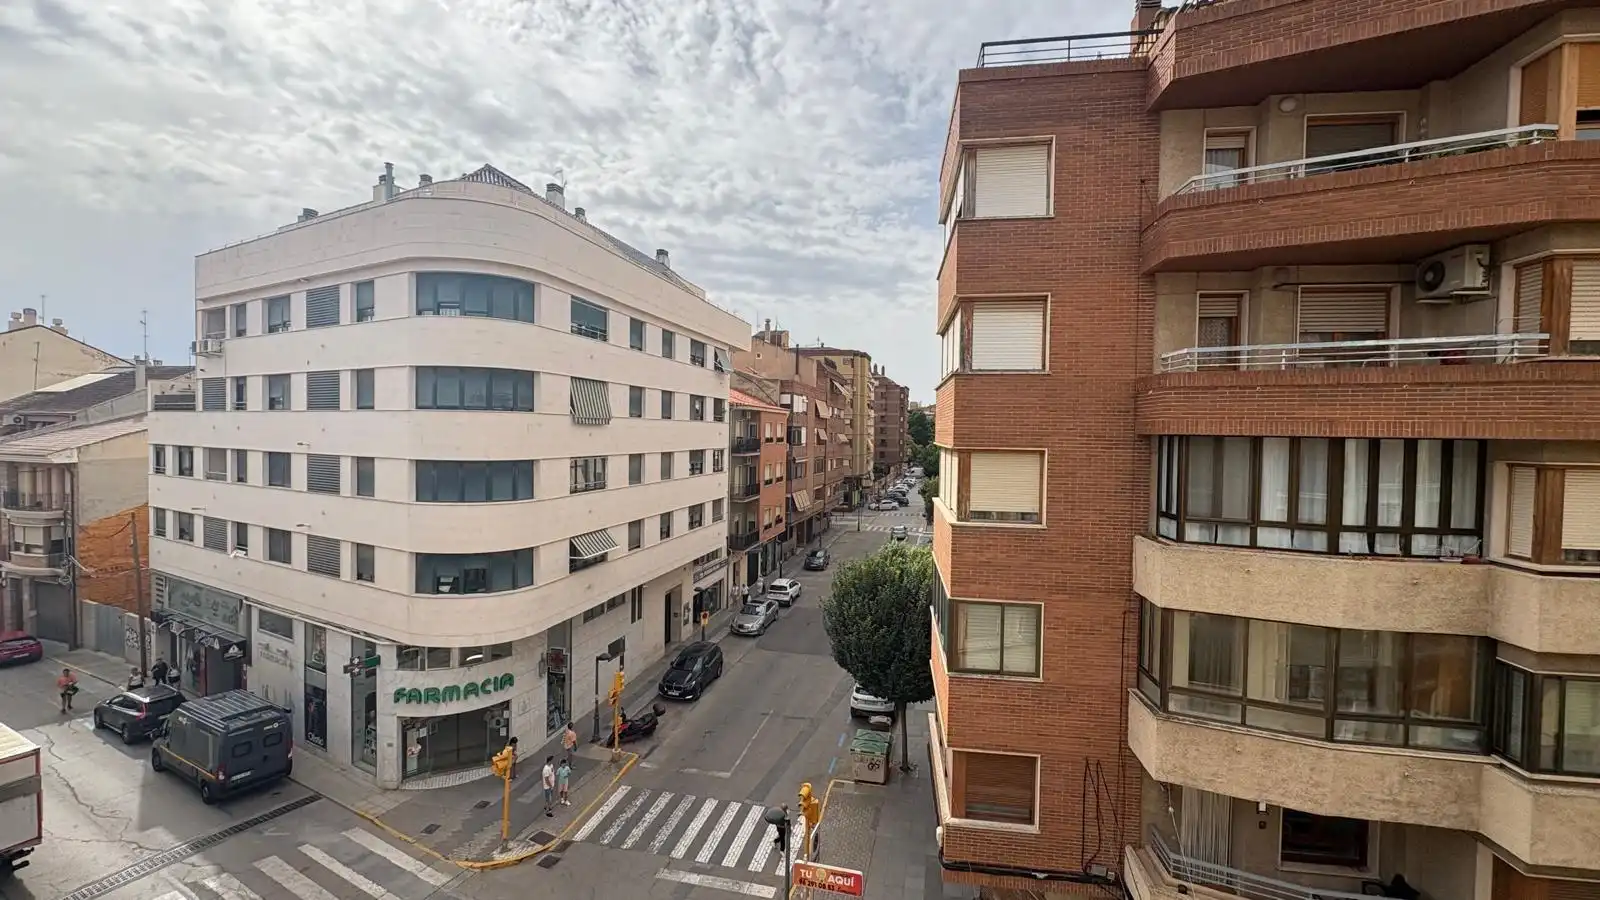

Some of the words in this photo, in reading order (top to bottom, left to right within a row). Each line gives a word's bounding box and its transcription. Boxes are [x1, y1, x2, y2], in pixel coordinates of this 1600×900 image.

[393, 672, 515, 705] FARMACIA
[800, 869, 813, 879] TU
[828, 874, 855, 887] AQUÍ
